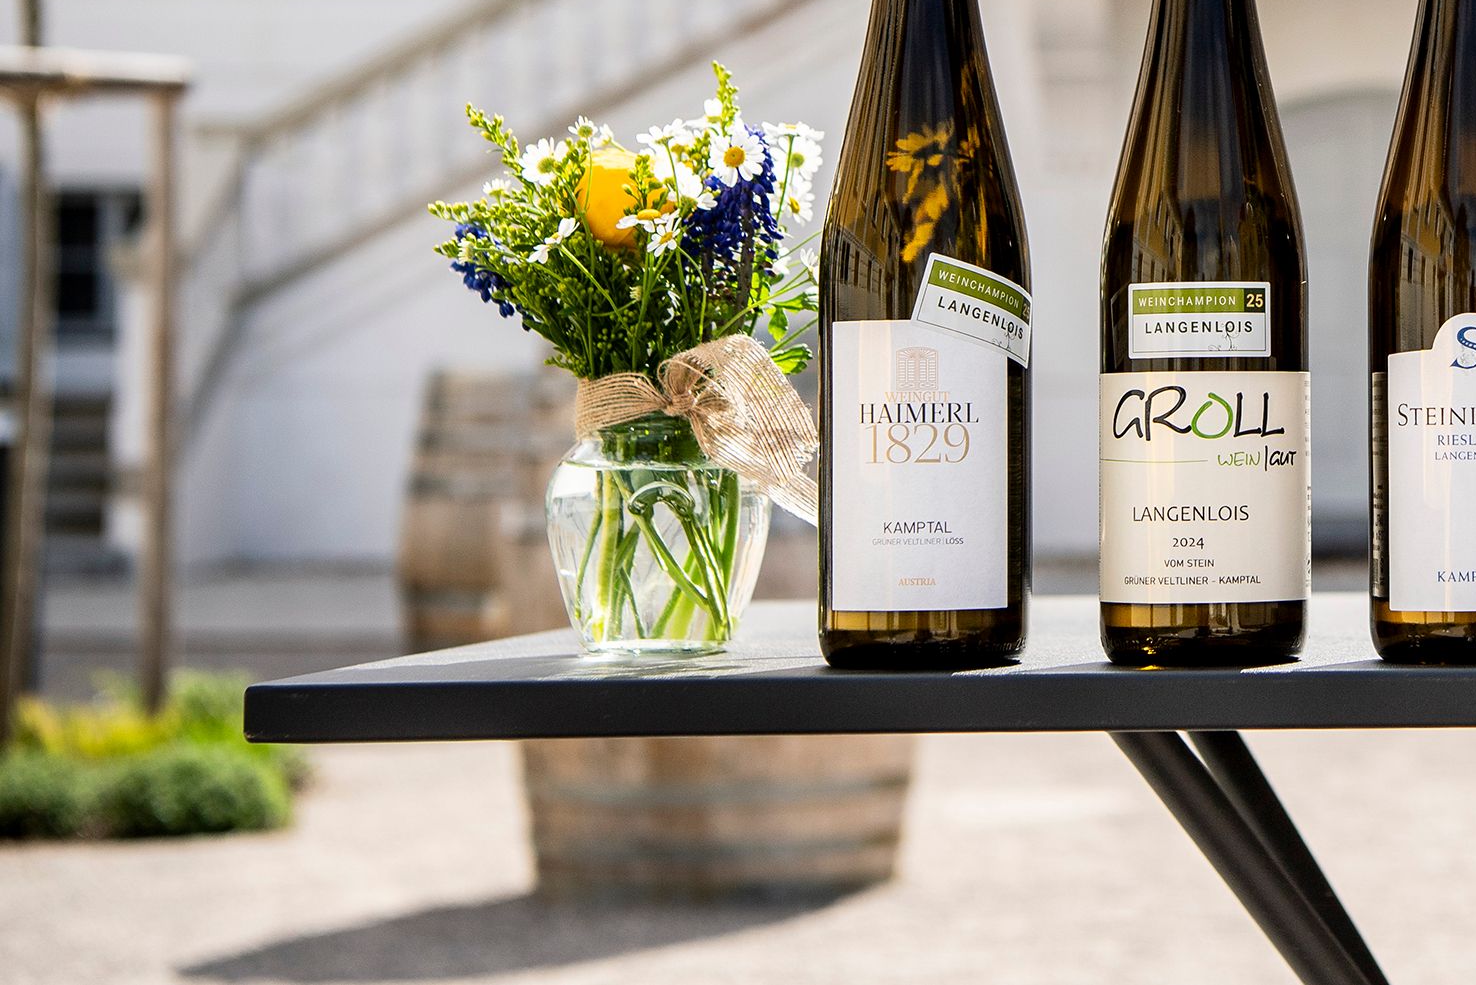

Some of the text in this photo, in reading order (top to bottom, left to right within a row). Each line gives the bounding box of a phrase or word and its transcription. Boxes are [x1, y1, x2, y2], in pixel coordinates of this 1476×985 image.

[938, 269, 1020, 309] WEINCHAMPION
[1138, 294, 1264, 308] WEINCHAMPION 25
[938, 295, 1024, 340] LANGENLOIS
[1145, 320, 1253, 334] LANGENLOIS
[884, 391, 950, 403] WEINGUT
[859, 402, 979, 424] HAIMERL
[1113, 385, 1285, 441] GROLL
[864, 423, 970, 464] 1829
[1133, 505, 1250, 522] LANGENLOIS
[883, 520, 952, 534] KAMPTAL
[903, 537, 941, 546] VELTLINER
[1172, 537, 1205, 550] 2024
[1164, 559, 1215, 568] VOM STEIN
[898, 577, 937, 586] AUSTRIA
[1124, 575, 1262, 585] GRÜNER VELTLINER KAMPTAL
